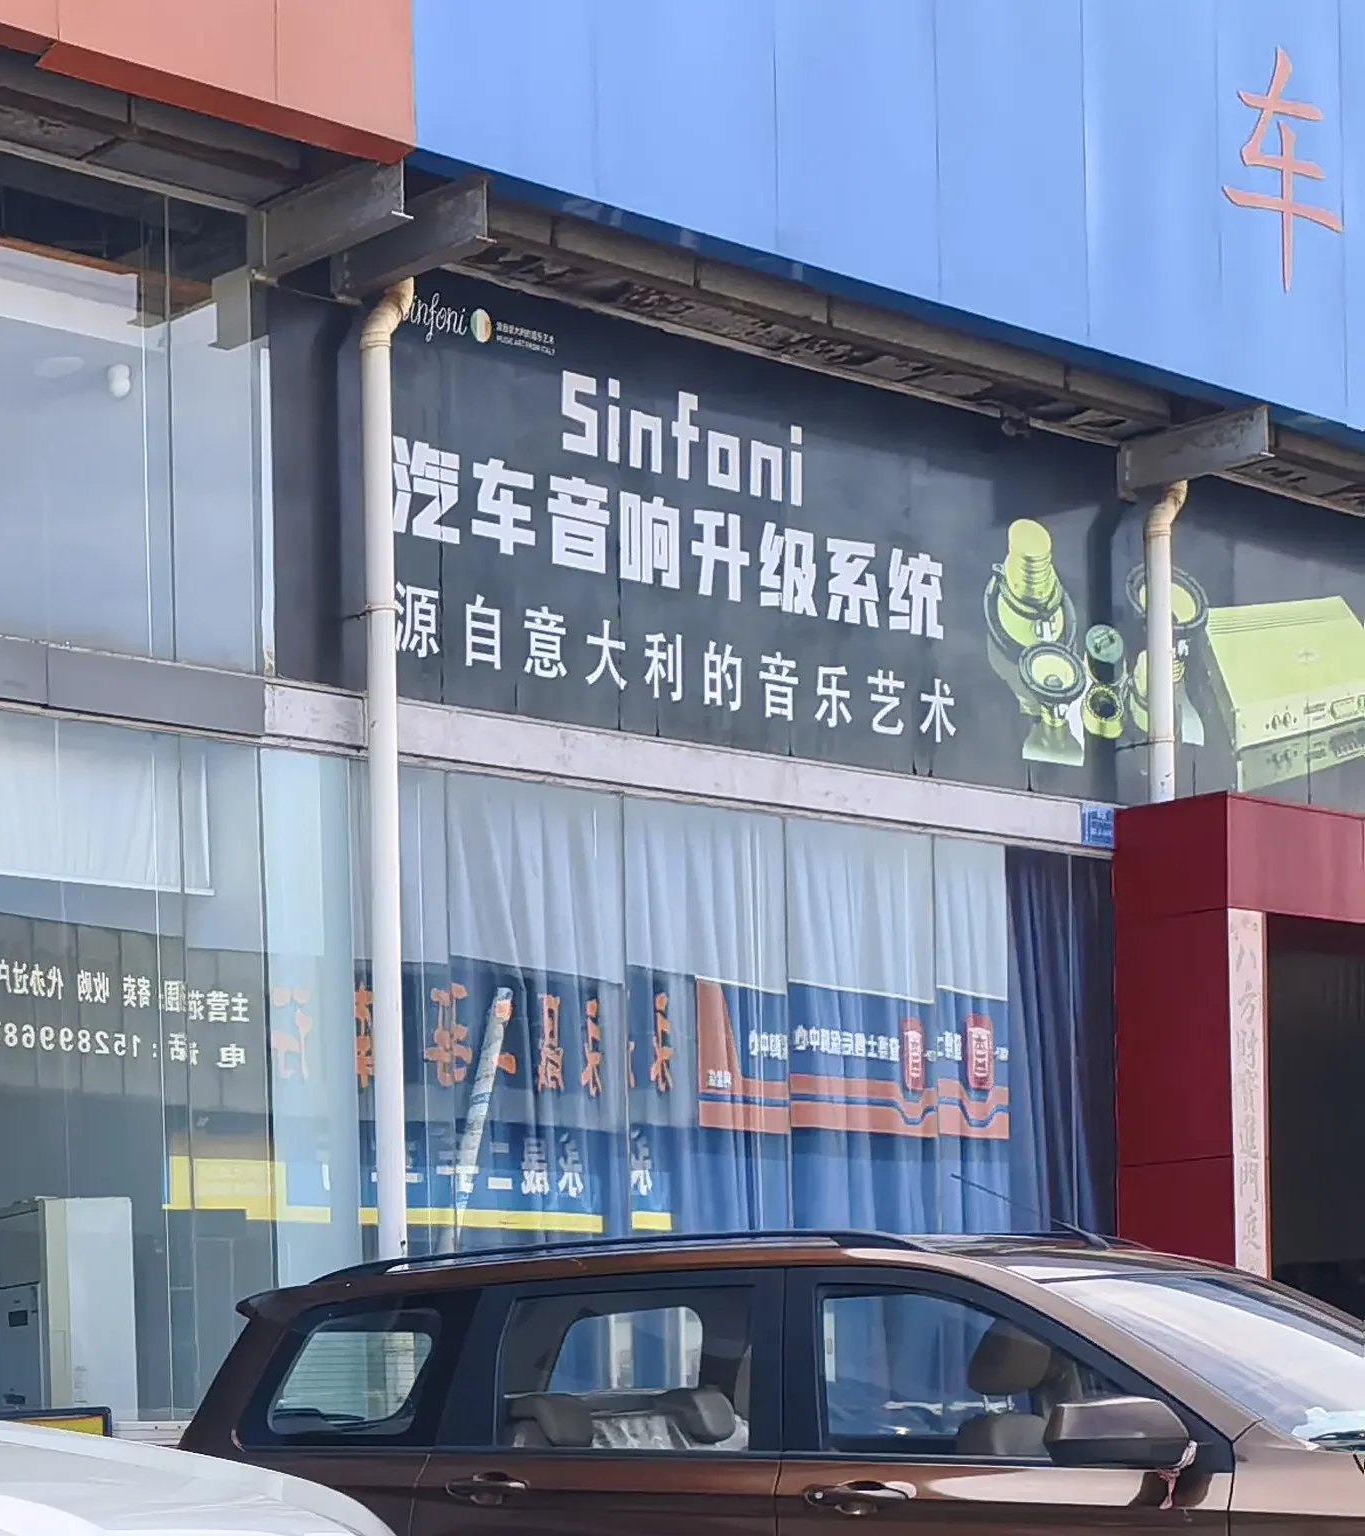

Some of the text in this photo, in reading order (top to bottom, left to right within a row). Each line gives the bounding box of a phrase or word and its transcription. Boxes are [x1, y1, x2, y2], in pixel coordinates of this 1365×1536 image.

[1222, 46, 1344, 293] 车
[562, 370, 804, 506] Sinfoni
[391, 435, 945, 639] 汽车音响升级系统
[394, 579, 956, 744] 源自意大利的音乐艺术
